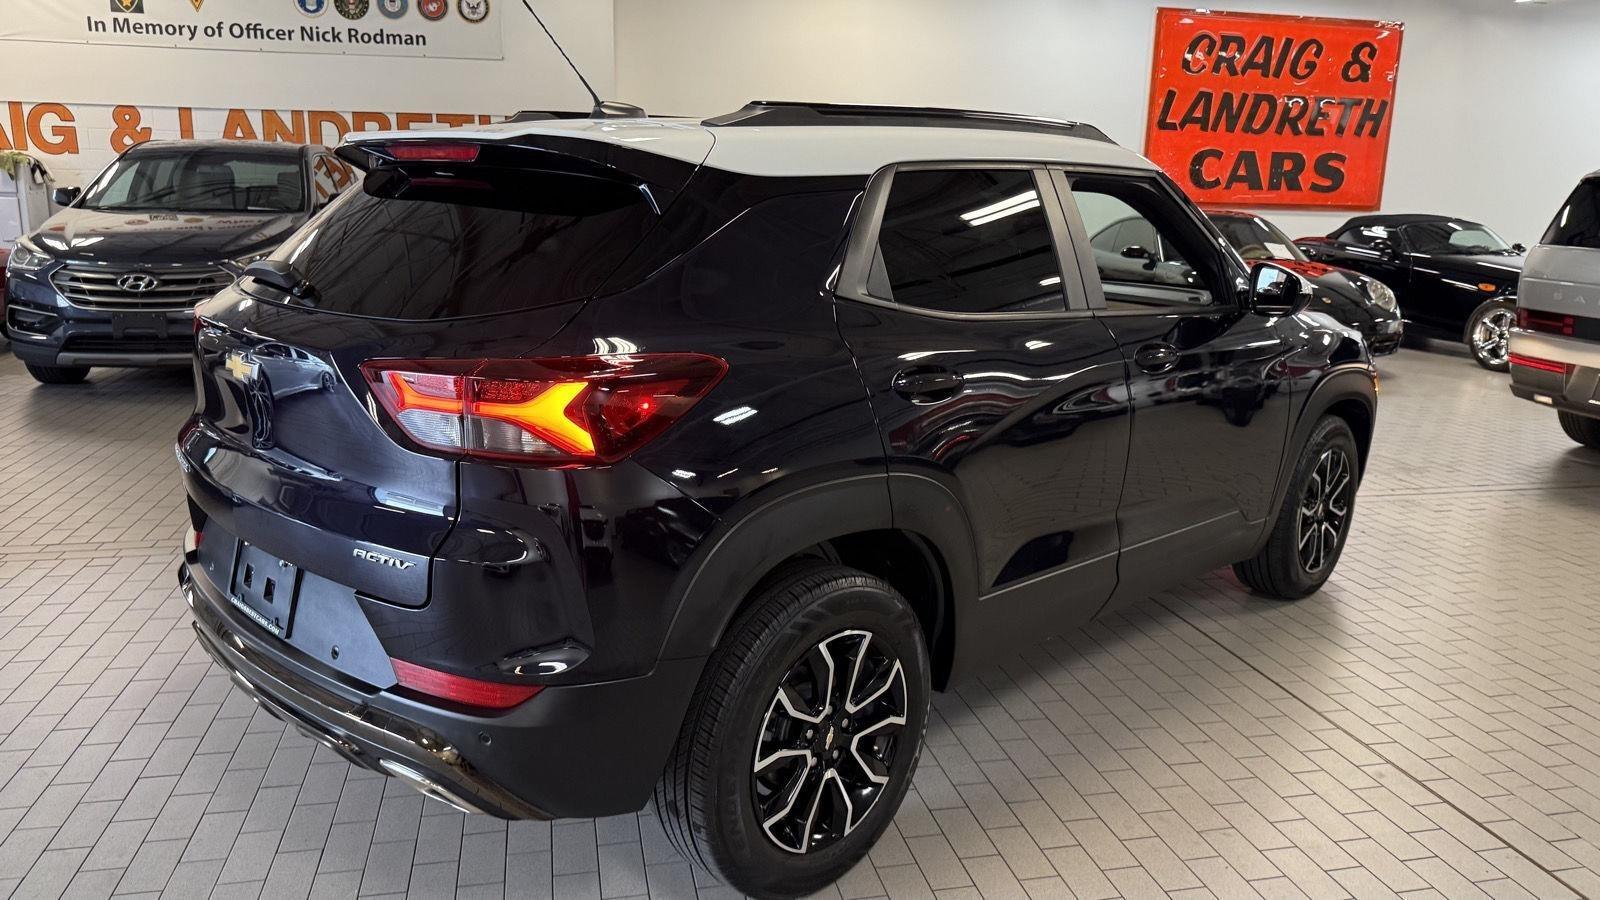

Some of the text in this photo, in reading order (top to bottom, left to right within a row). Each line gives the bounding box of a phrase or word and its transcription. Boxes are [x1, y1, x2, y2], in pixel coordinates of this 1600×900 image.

[87, 16, 427, 46] In Memory of Officer Nick Rodman
[1181, 31, 1378, 83] CRAIG &
[110, 104, 153, 154] &
[1157, 89, 1389, 138] LANDRETH
[1189, 148, 1347, 193] CARS
[353, 548, 416, 570] ACTIV
